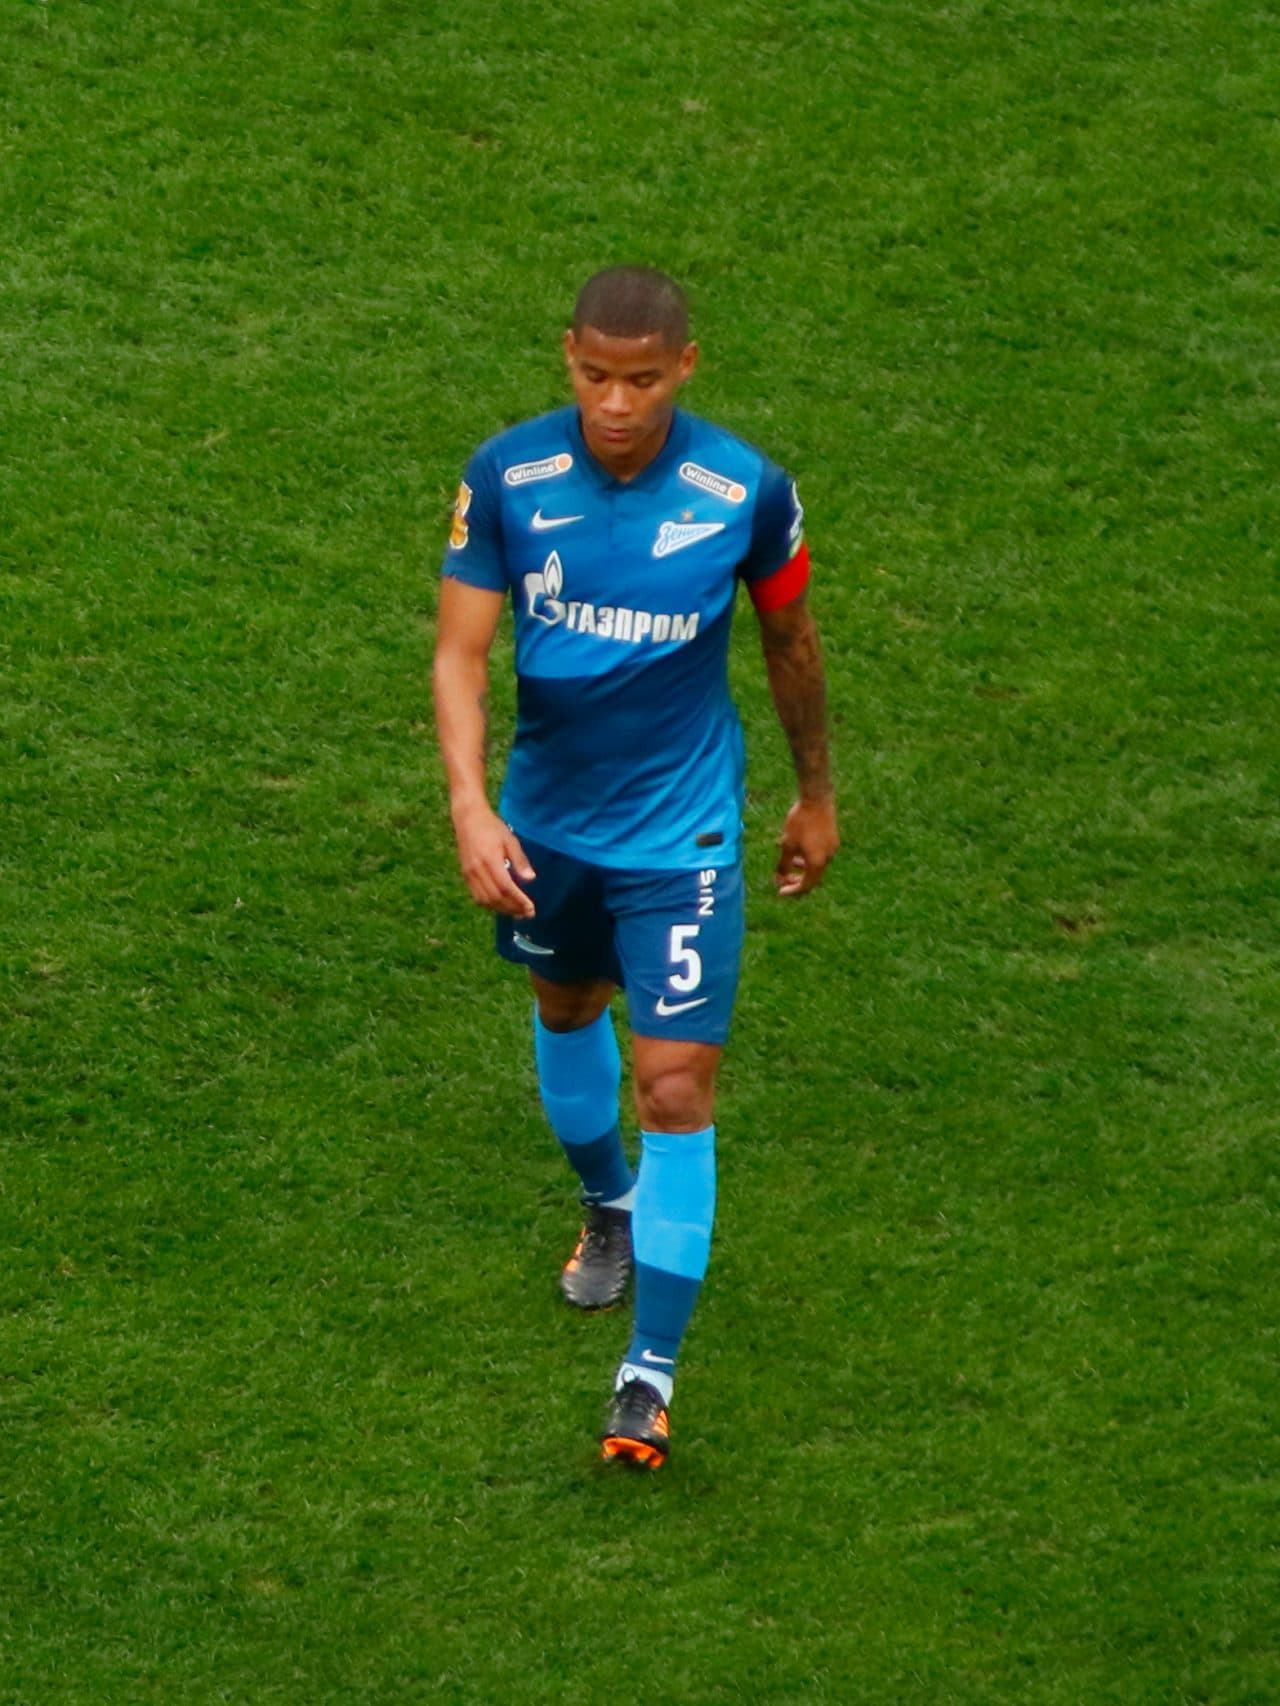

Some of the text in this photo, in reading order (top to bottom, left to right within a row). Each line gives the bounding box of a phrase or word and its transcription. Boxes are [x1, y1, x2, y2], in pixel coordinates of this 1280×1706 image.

[511, 463, 554, 481] Winline
[686, 466, 727, 492] Winline
[564, 601, 700, 643] ГАЗПРОМ
[669, 924, 702, 993] 5
